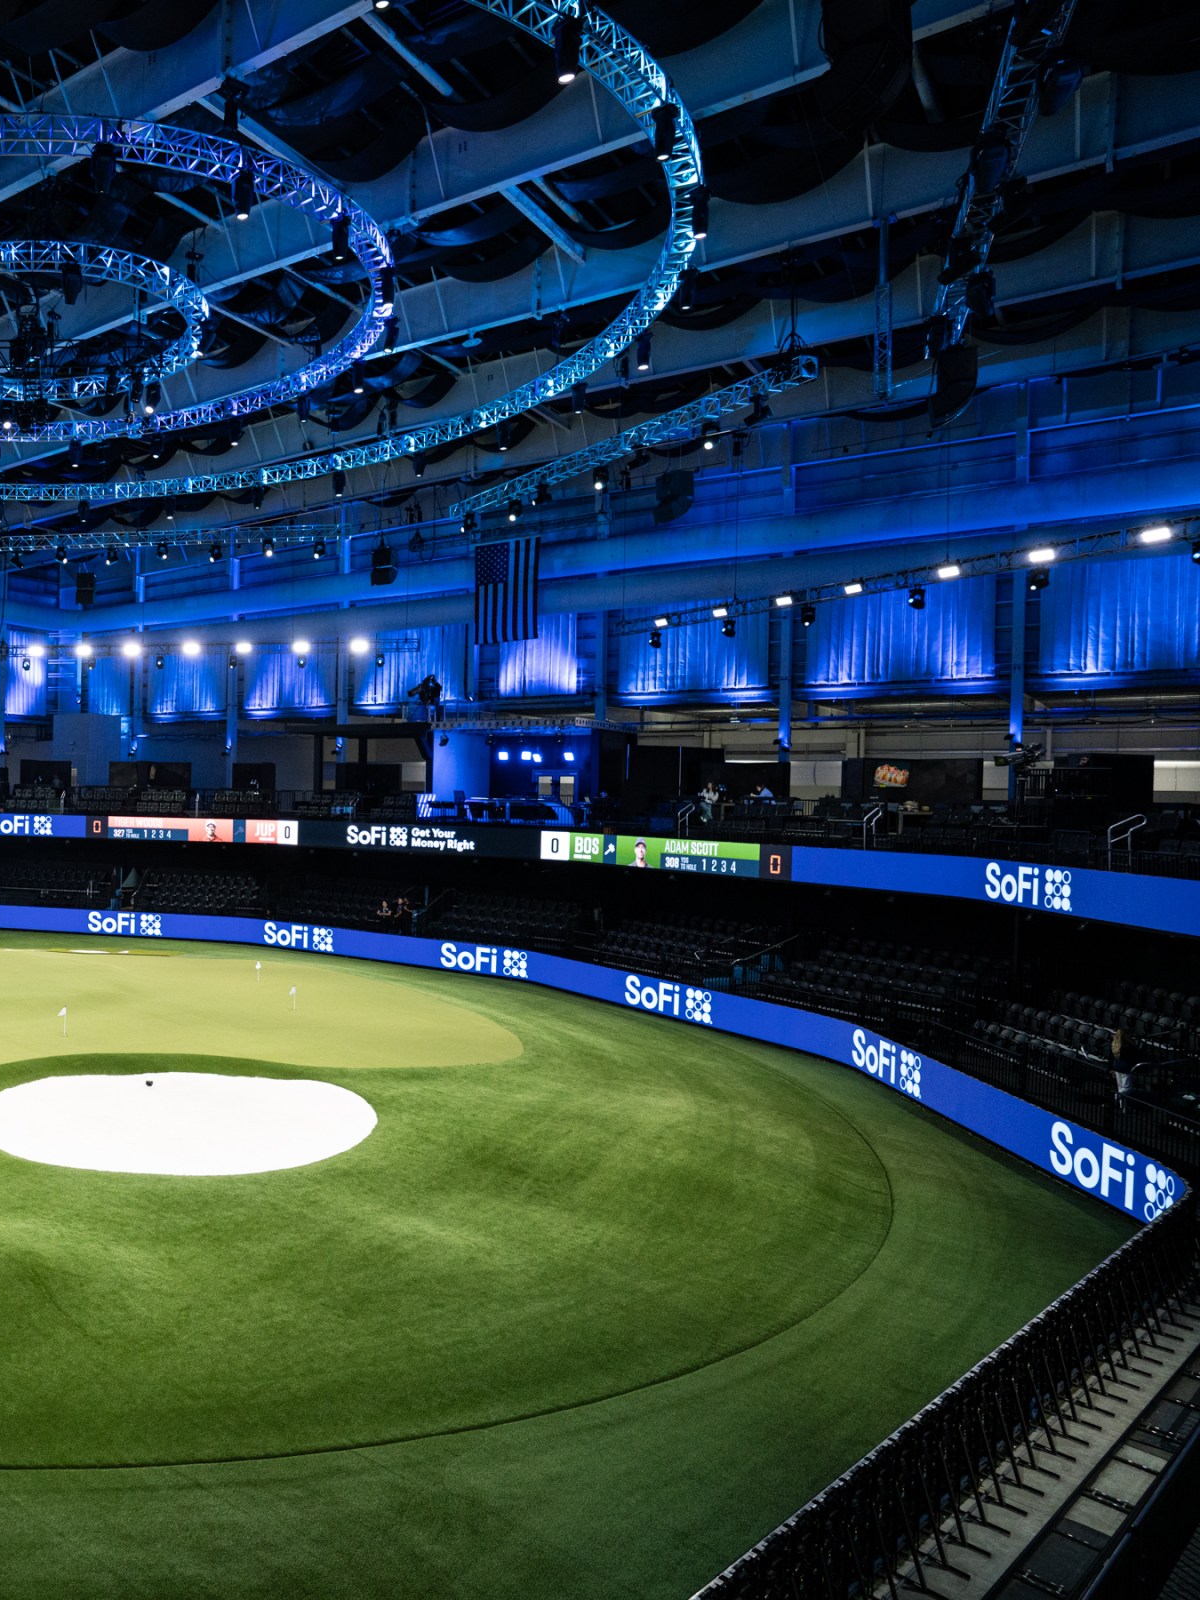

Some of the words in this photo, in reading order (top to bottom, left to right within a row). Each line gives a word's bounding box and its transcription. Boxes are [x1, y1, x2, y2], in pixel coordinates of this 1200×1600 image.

[113, 828, 125, 838] 327
[144, 829, 148, 838] 1
[151, 829, 157, 839] 2
[159, 829, 164, 839] 3
[166, 829, 172, 839] 4
[254, 822, 276, 837] JUP
[284, 825, 291, 839] 0
[346, 825, 387, 846] SoFi
[411, 827, 431, 838] Get
[431, 827, 456, 839] Your
[411, 837, 446, 851] Money
[446, 838, 475, 852] Right
[551, 837, 559, 854] 0
[574, 836, 600, 855] BOS
[664, 840, 689, 854] ADAM
[690, 841, 719, 856] SCOTT
[665, 856, 680, 869] 308
[701, 858, 707, 871] 1
[711, 859, 717, 872] 2
[720, 860, 727, 873] 3
[730, 861, 736, 874] 4
[985, 862, 1039, 906] SoFi
[88, 911, 136, 934] SoFi
[264, 921, 309, 948] SoFi
[440, 942, 498, 973] SoFi
[625, 975, 680, 1016] SoFi
[851, 1029, 896, 1084] SoFi
[1049, 1121, 1135, 1211] SoFi
